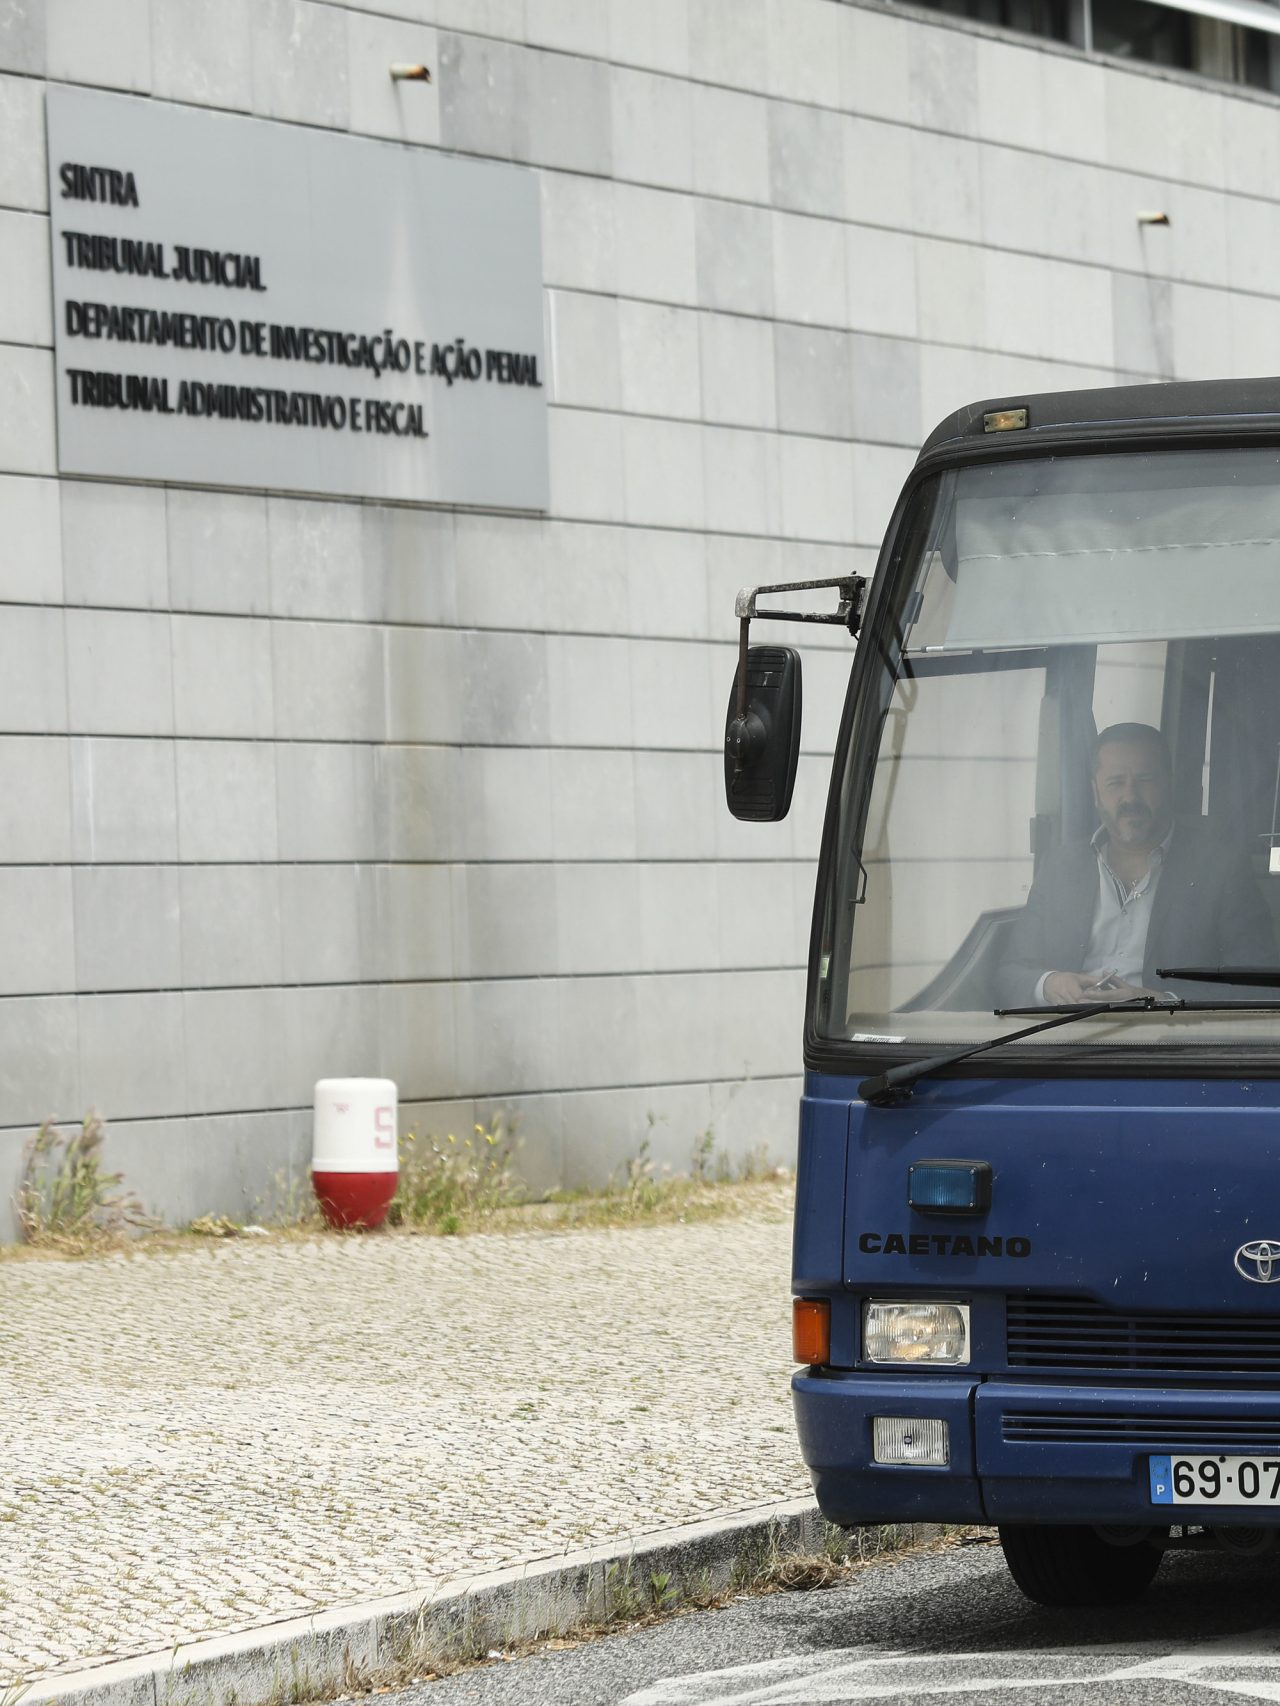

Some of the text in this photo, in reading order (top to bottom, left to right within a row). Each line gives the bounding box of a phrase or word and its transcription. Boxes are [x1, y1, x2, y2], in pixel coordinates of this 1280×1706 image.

[60, 162, 139, 208] SINTRA
[61, 230, 267, 291] TRIBUNAL JUDICIAL
[66, 300, 543, 387] DEPARTAMENTO DE INVESTIGAÇÃO E AÇÃO PENAL
[66, 368, 429, 440] TRIBUNAL ADMINISTRATIVO E FISCAL
[858, 1232, 1031, 1258] CAETANO
[1156, 1484, 1165, 1496] P
